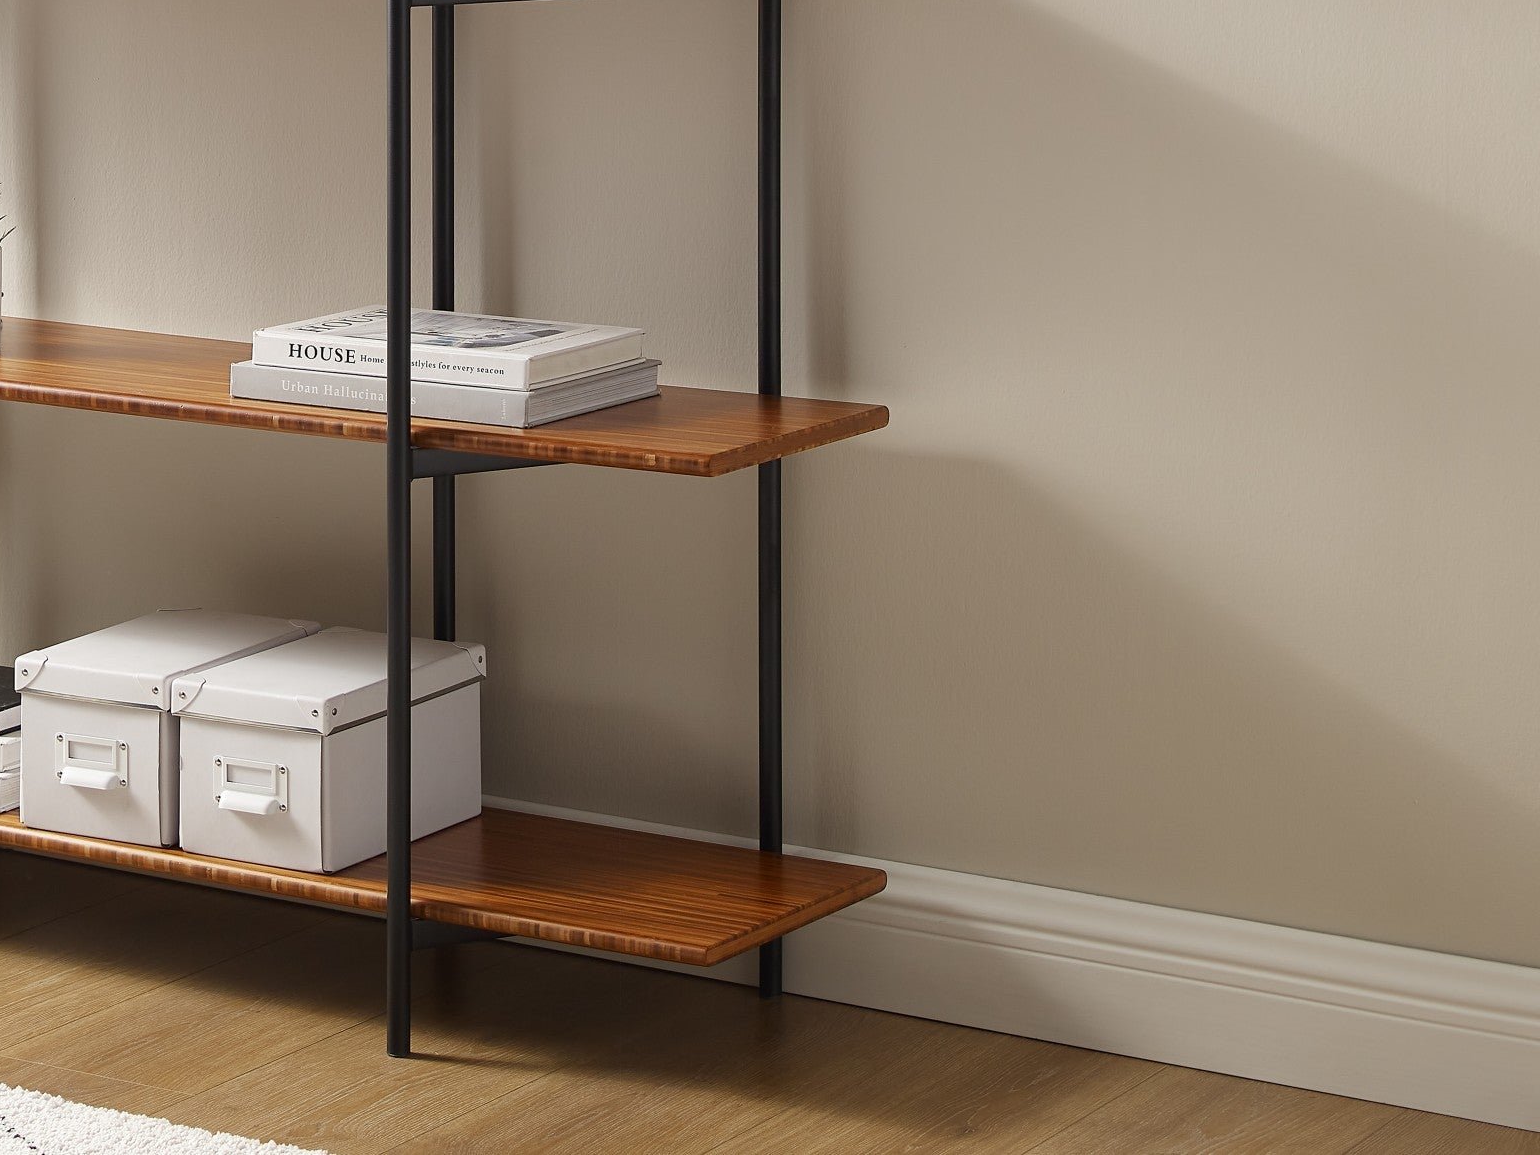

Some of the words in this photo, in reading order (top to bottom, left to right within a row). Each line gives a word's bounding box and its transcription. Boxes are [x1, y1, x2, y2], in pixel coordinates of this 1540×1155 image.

[288, 343, 356, 364] HOUSE
[360, 354, 385, 364] Home
[438, 361, 450, 370] for
[452, 364, 475, 374] every
[281, 380, 319, 394] Urban
